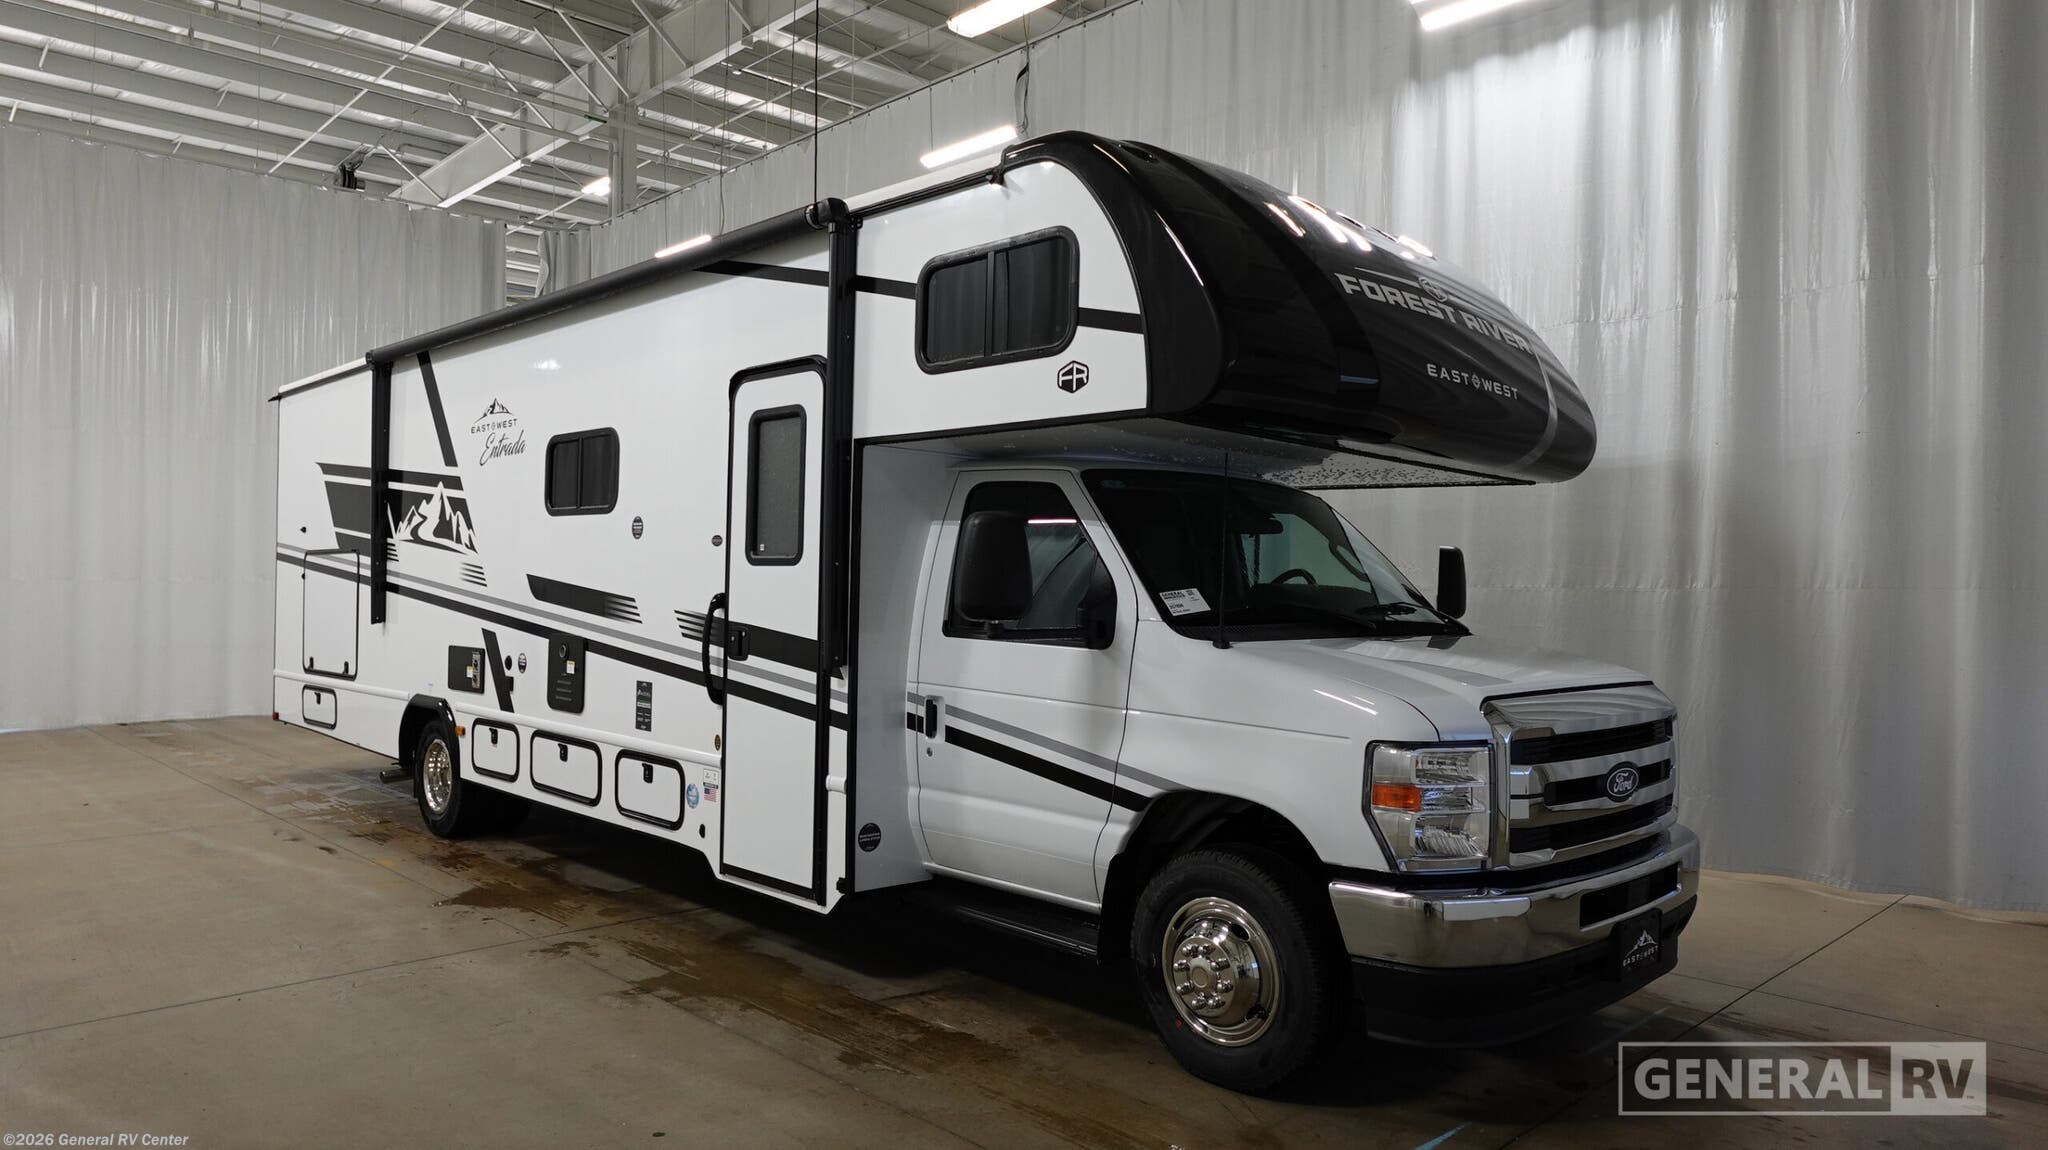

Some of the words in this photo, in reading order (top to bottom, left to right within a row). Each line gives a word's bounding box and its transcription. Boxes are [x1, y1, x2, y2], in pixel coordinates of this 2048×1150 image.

[1334, 272, 1457, 324] FOREST
[1459, 310, 1534, 355] RIVER
[1426, 363, 1469, 386] EAST
[1481, 379, 1519, 400] WEST
[479, 429, 526, 467] Entrada
[1613, 772, 1634, 793] Ford
